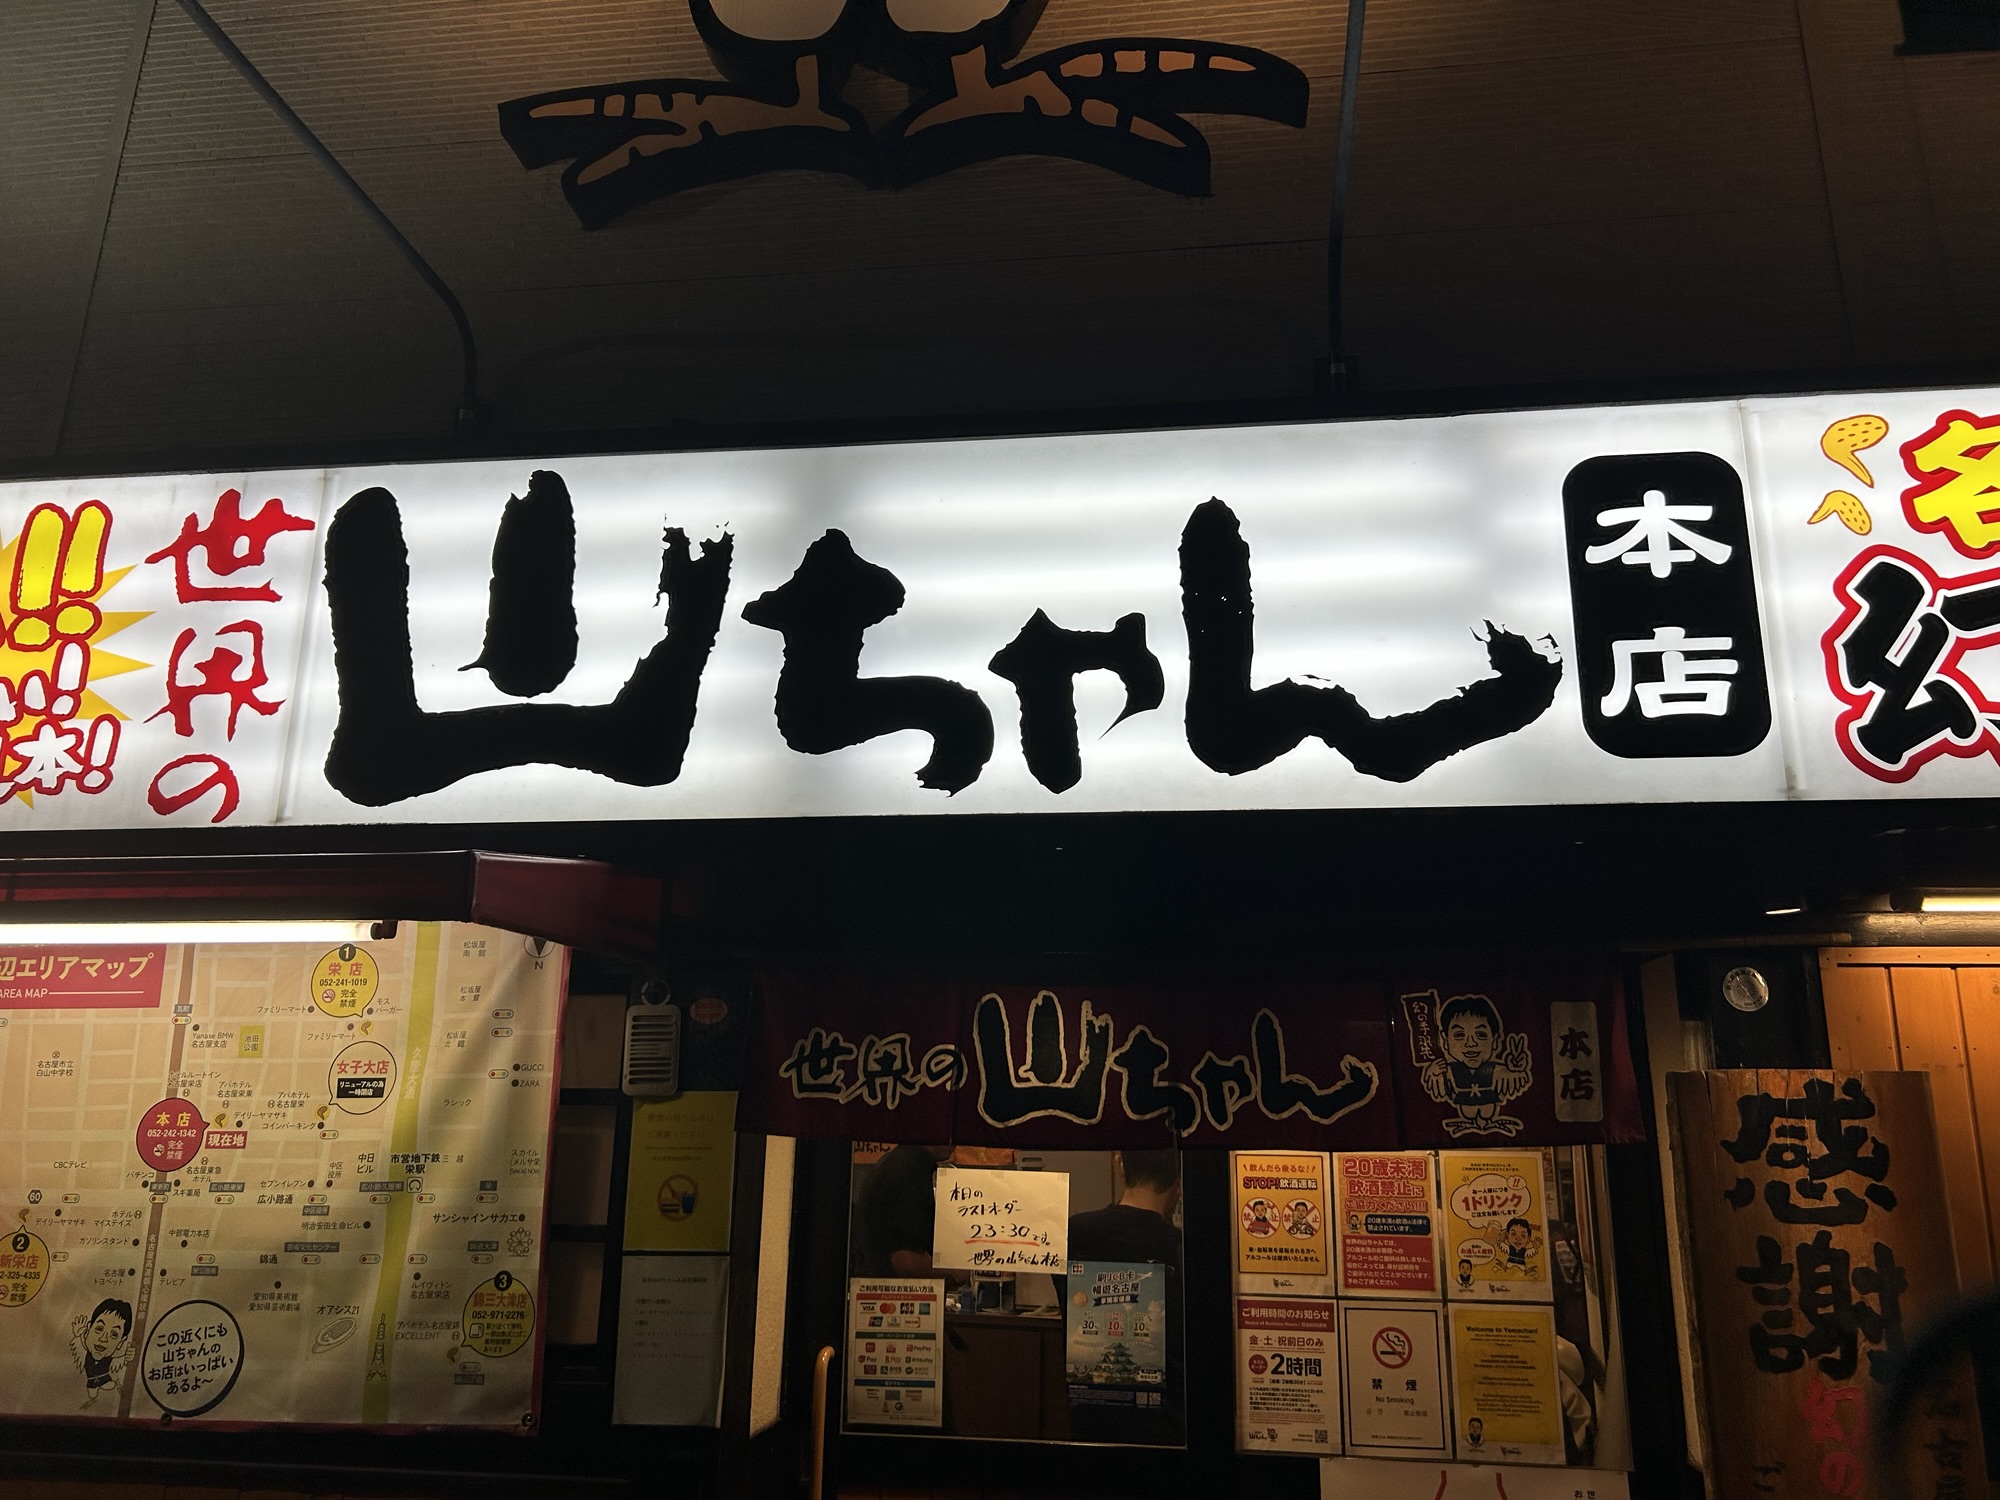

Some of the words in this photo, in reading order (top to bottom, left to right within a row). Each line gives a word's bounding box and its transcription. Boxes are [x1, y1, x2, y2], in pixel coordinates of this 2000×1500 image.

[1584, 489, 1739, 719] 本店
[323, 470, 1563, 807] 山ちゃん
[145, 489, 315, 824] 世界の
[328, 962, 363, 976] 栄店
[534, 961, 543, 970] N
[320, 978, 368, 986] 052-241-1019
[25, 988, 48, 998] MAP
[341, 989, 357, 998] 完全
[340, 999, 356, 1008] 禁煙
[244, 1044, 258, 1052] 公園
[38, 1060, 74, 1068] 名古屋市立
[337, 1060, 389, 1074] 女子大店
[780, 990, 1380, 1136] 世界の山ちゃん
[1558, 1027, 1594, 1100] 本店
[36, 1069, 74, 1077] 白山中学校
[444, 1098, 472, 1106] ラシック
[156, 1112, 191, 1126] 本店
[234, 1112, 288, 1120] デイリーヤマザキ
[147, 1129, 196, 1138] 052-242-1342
[208, 1133, 244, 1146] 現在地
[168, 1140, 184, 1150] 完全
[166, 1150, 182, 1160] 禁煙
[358, 1153, 374, 1163] 中日
[390, 1154, 440, 1164] 市営地下鉄
[186, 1166, 222, 1174] 名古屋東急
[357, 1164, 374, 1173] ビル
[405, 1164, 426, 1174] 栄駅
[1250, 1164, 1310, 1173] 飲んだら乗るな!
[1344, 1158, 1426, 1179] 20歳未満
[1243, 1176, 1318, 1190] STOP!飲酒運転
[173, 1189, 200, 1197] スギ薬局
[950, 1182, 983, 1201] 本日の
[1348, 1180, 1424, 1198] 飲酒禁止に
[30, 1192, 40, 1200] 60
[258, 1194, 293, 1204] 広小路通
[1462, 1193, 1522, 1211] 1ドリンク
[433, 1213, 518, 1223] サンシャインサカエ
[302, 1222, 361, 1230] 明治安田生命ビル
[1720, 1077, 1907, 1382] 感謝
[169, 1229, 210, 1238] 中部電力本店
[17, 1236, 24, 1250] 2
[0, 1254, 39, 1268] 新栄店
[260, 1254, 278, 1264] 錦通
[104, 1269, 126, 1277] 名古屋
[500, 1274, 508, 1288] 3
[11, 1283, 28, 1292] 完全
[10, 1293, 26, 1302] 禁煙
[253, 1292, 298, 1300] 愛知県美術館
[410, 1290, 450, 1299] 名古屋栄店
[248, 1303, 300, 1312] 愛知県芸術劇場
[317, 1305, 360, 1314] オアシス21
[472, 1310, 524, 1319] 052-971-2276
[1242, 1307, 1330, 1320] ご利用時間のお知らせ
[156, 1322, 228, 1347] この近くにも
[1249, 1335, 1324, 1348] 金・土・祝前日のみ
[163, 1342, 220, 1363] 山ちゃんの
[148, 1356, 234, 1380] お店はいっぱい
[1270, 1353, 1322, 1376] 2時間
[1386, 1396, 1414, 1404] Smoking
